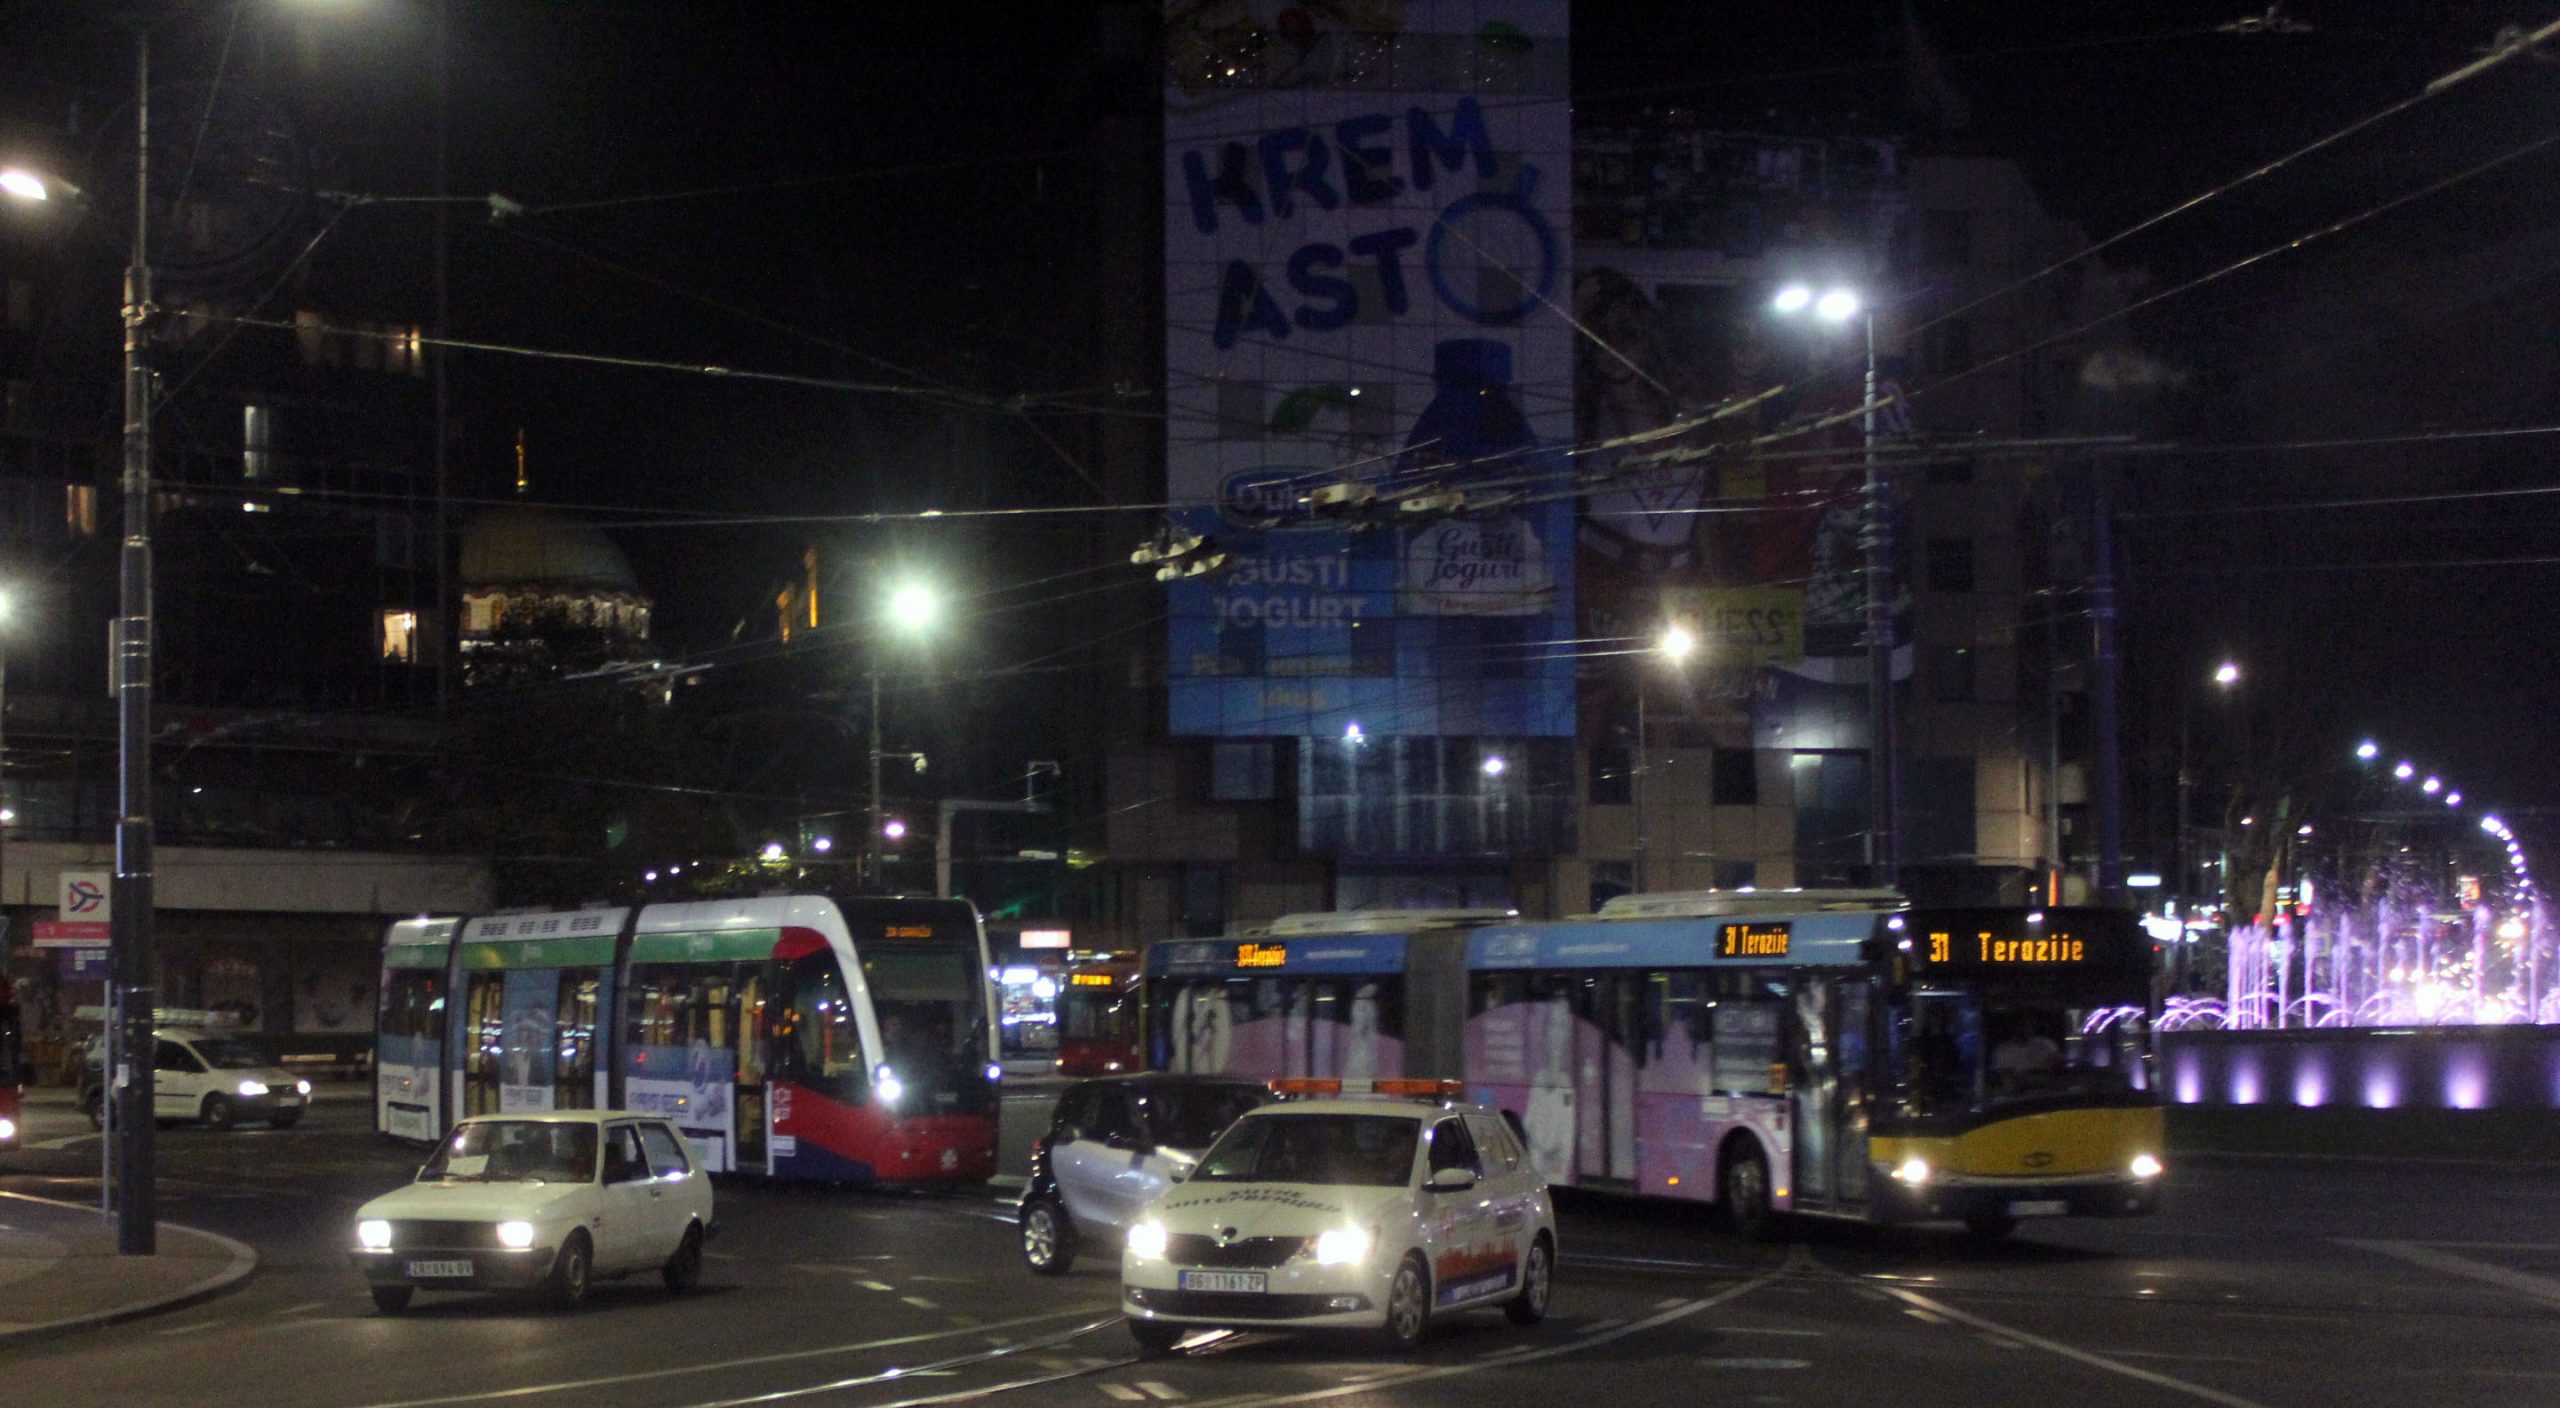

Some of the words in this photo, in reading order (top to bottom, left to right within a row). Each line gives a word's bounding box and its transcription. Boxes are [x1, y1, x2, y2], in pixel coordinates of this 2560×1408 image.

[1182, 96, 1498, 234] KREM
[1741, 925, 1788, 954] Terazije
[1929, 933, 1949, 962] 31
[1978, 933, 2083, 962] Terazije
